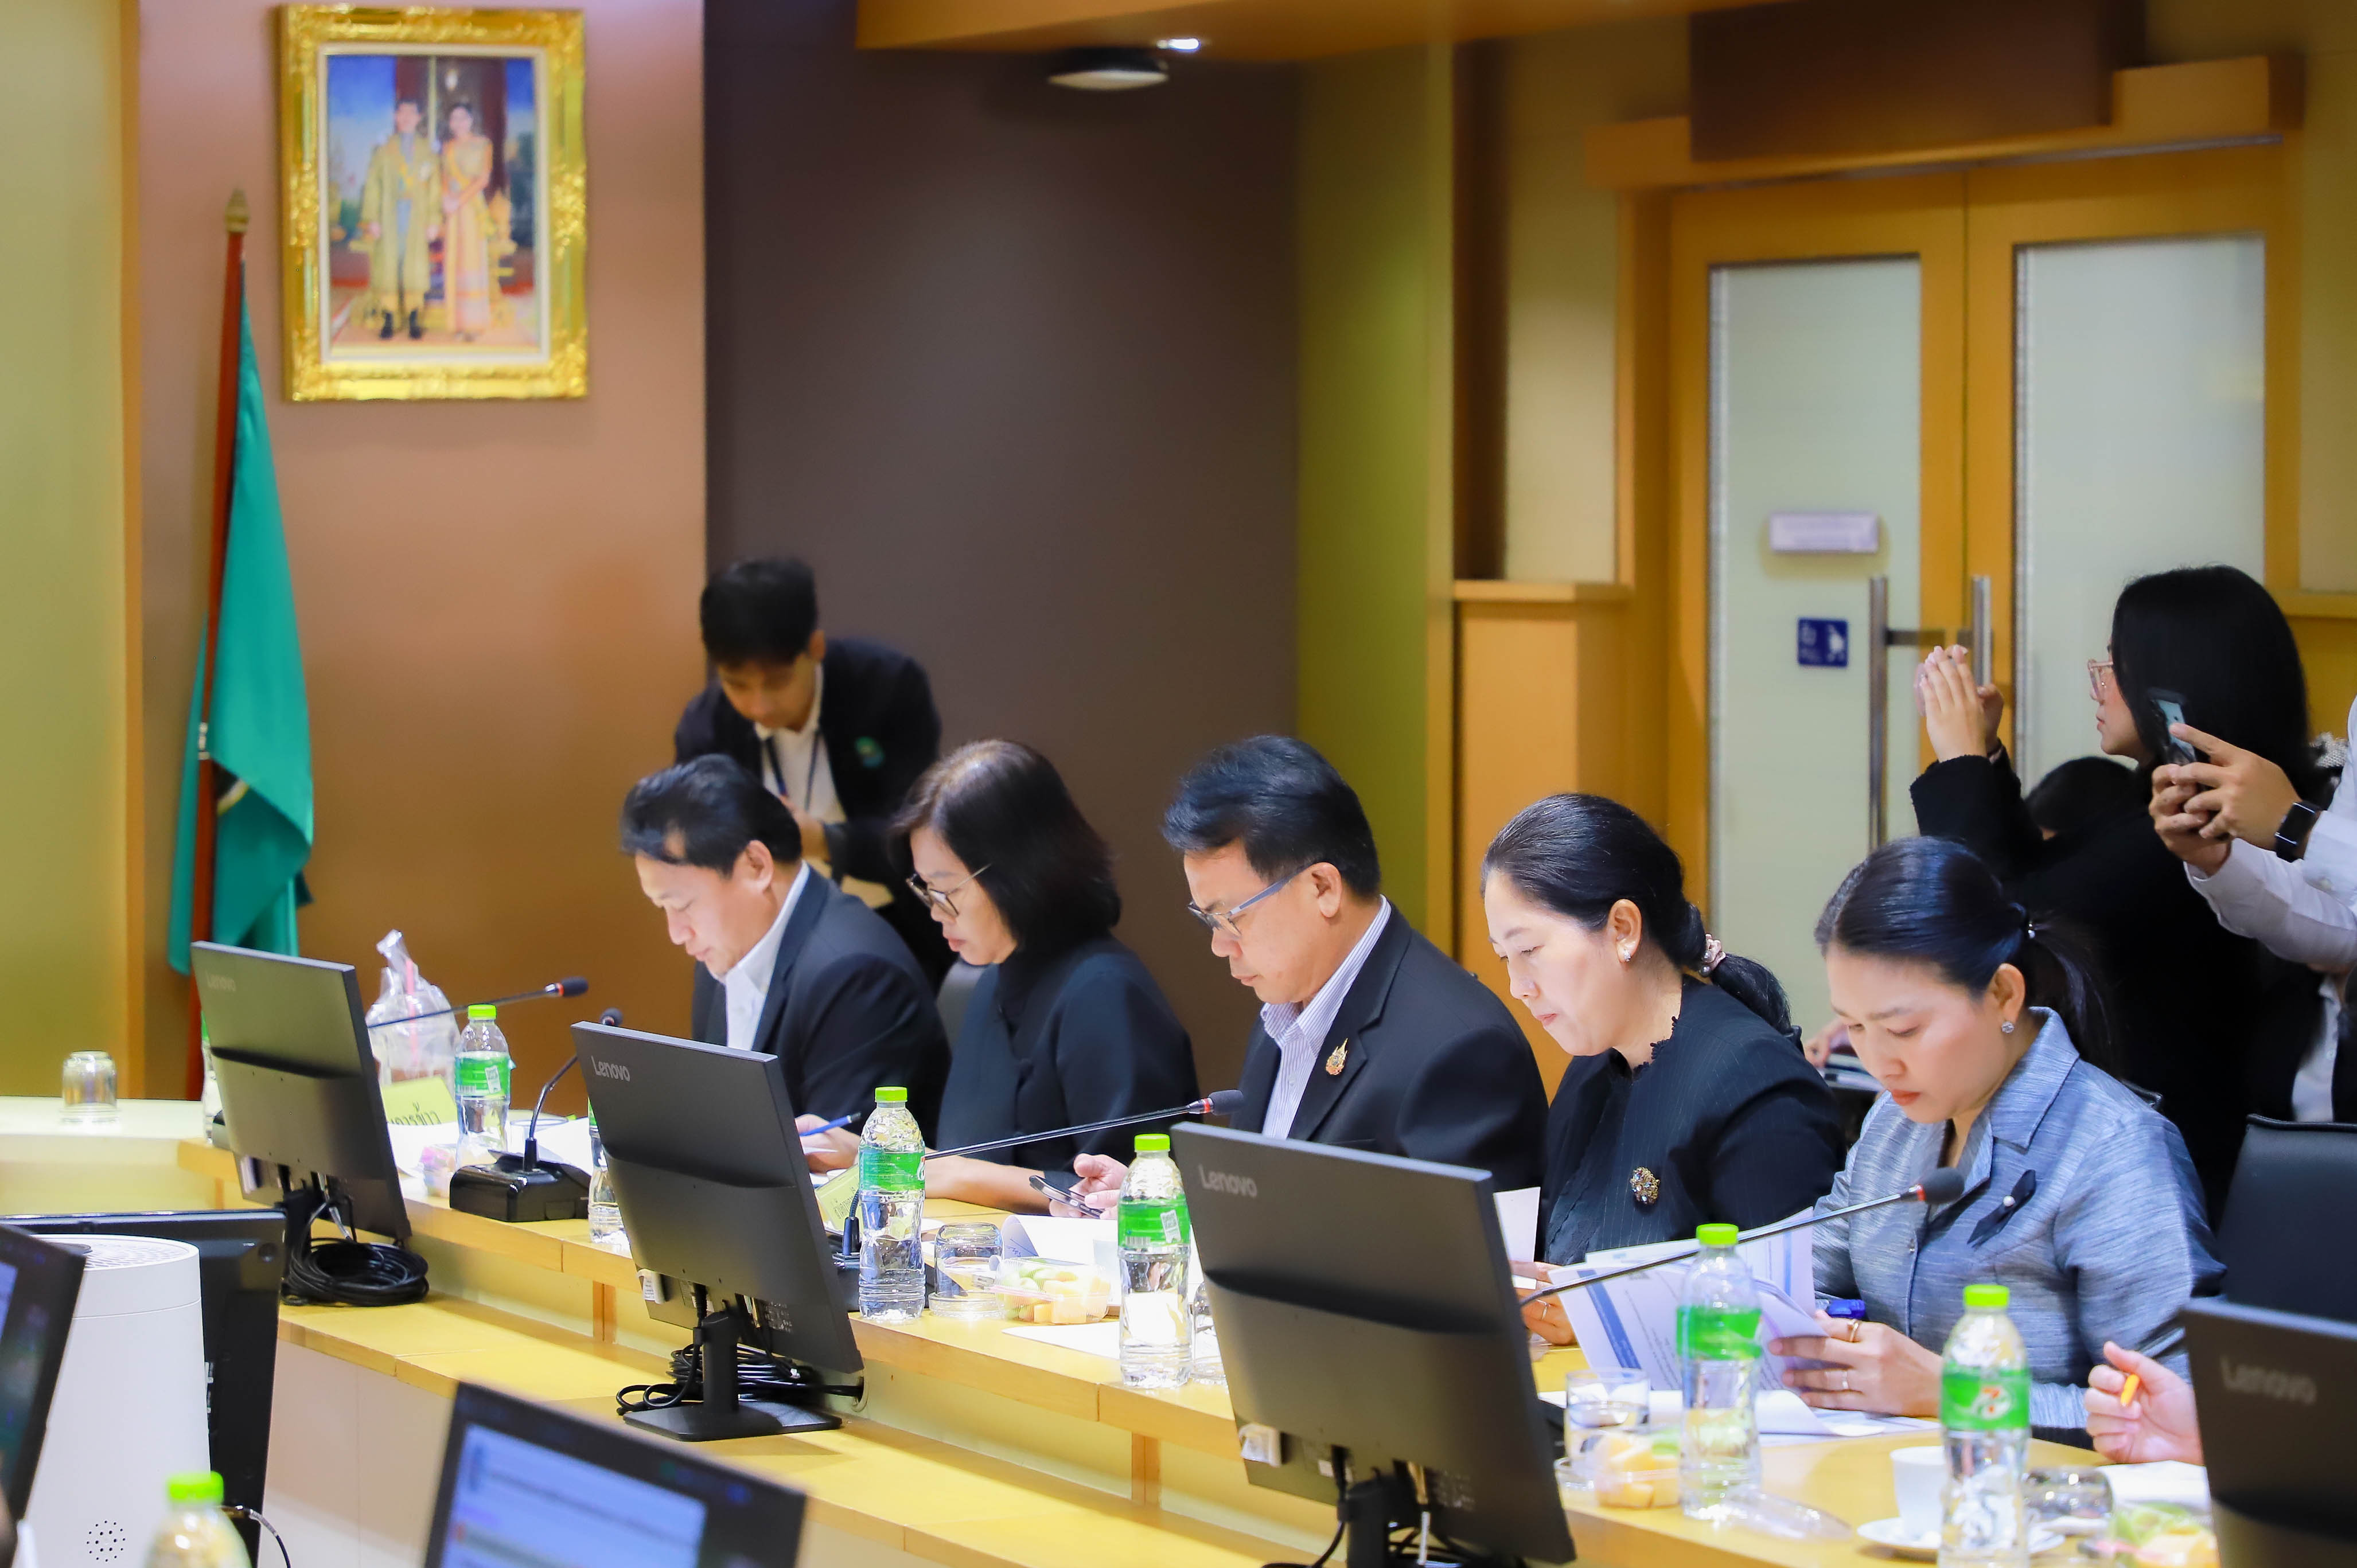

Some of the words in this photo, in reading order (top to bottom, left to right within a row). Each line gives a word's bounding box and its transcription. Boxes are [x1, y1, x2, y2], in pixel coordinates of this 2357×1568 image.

[590, 1055, 630, 1083] Lenovo
[1197, 1163, 1258, 1198] Lenovo
[2219, 1354, 2317, 1406] Lenovo
